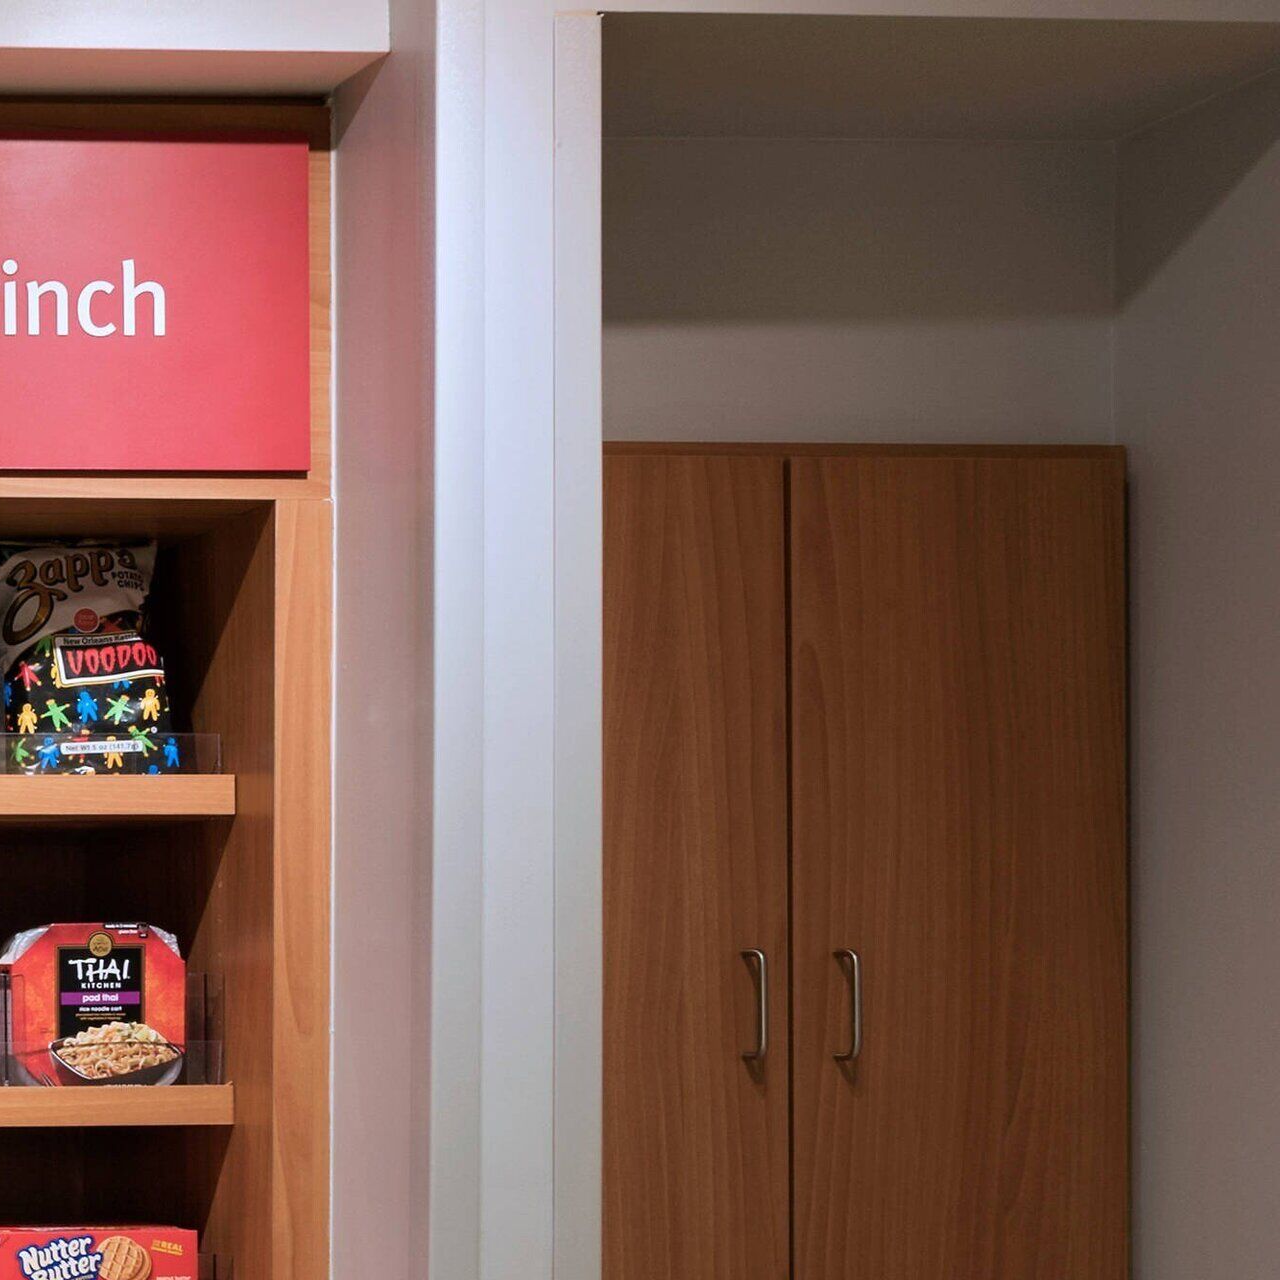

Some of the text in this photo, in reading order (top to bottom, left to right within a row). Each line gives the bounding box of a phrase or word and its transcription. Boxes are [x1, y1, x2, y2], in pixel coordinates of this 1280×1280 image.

[63, 636, 113, 646] New Orleans
[66, 642, 158, 676] VOODOO
[67, 958, 130, 983] THAI
[82, 993, 119, 1004] pad thai
[20, 1236, 93, 1275] Nutter
